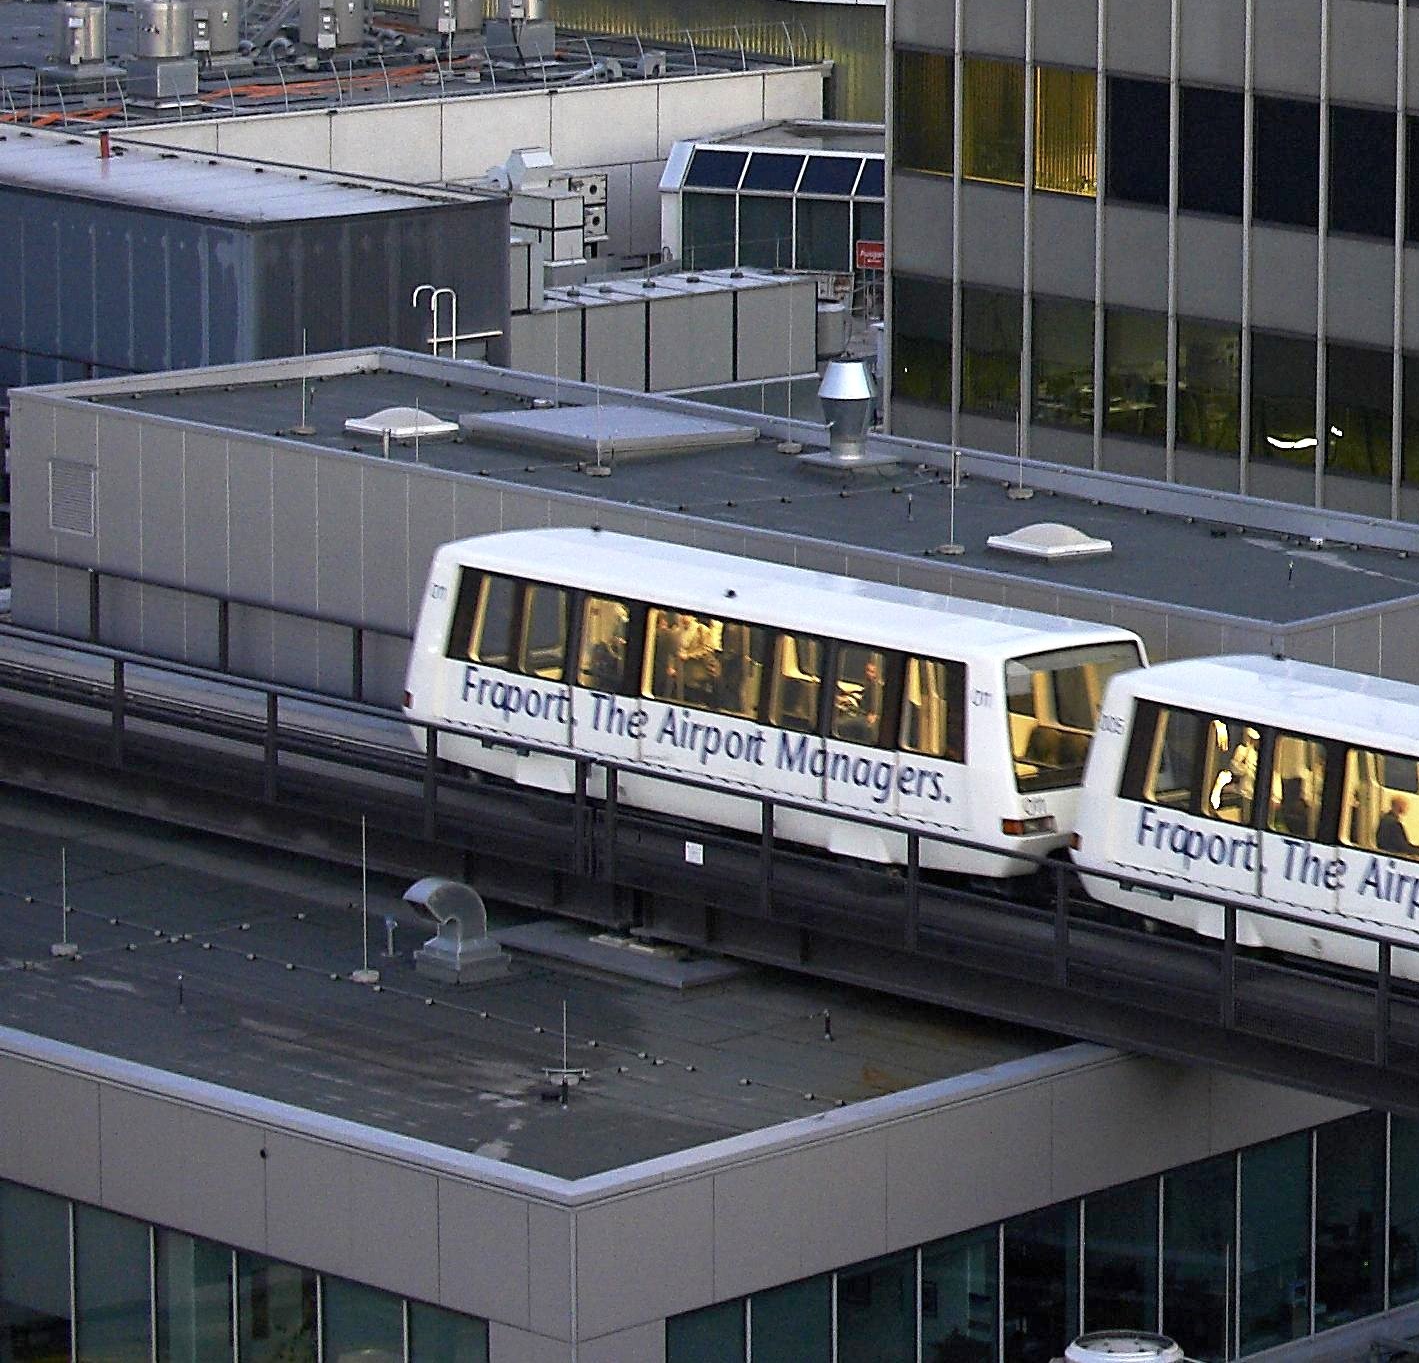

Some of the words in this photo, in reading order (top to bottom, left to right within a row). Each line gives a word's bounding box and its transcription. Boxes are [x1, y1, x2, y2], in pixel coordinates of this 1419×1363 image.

[461, 665, 577, 727] Fraport.
[590, 692, 649, 740] The
[656, 706, 766, 766] Airport
[775, 731, 952, 804] Managers.
[1137, 806, 1267, 874] Fraport.
[1282, 838, 1347, 891] The
